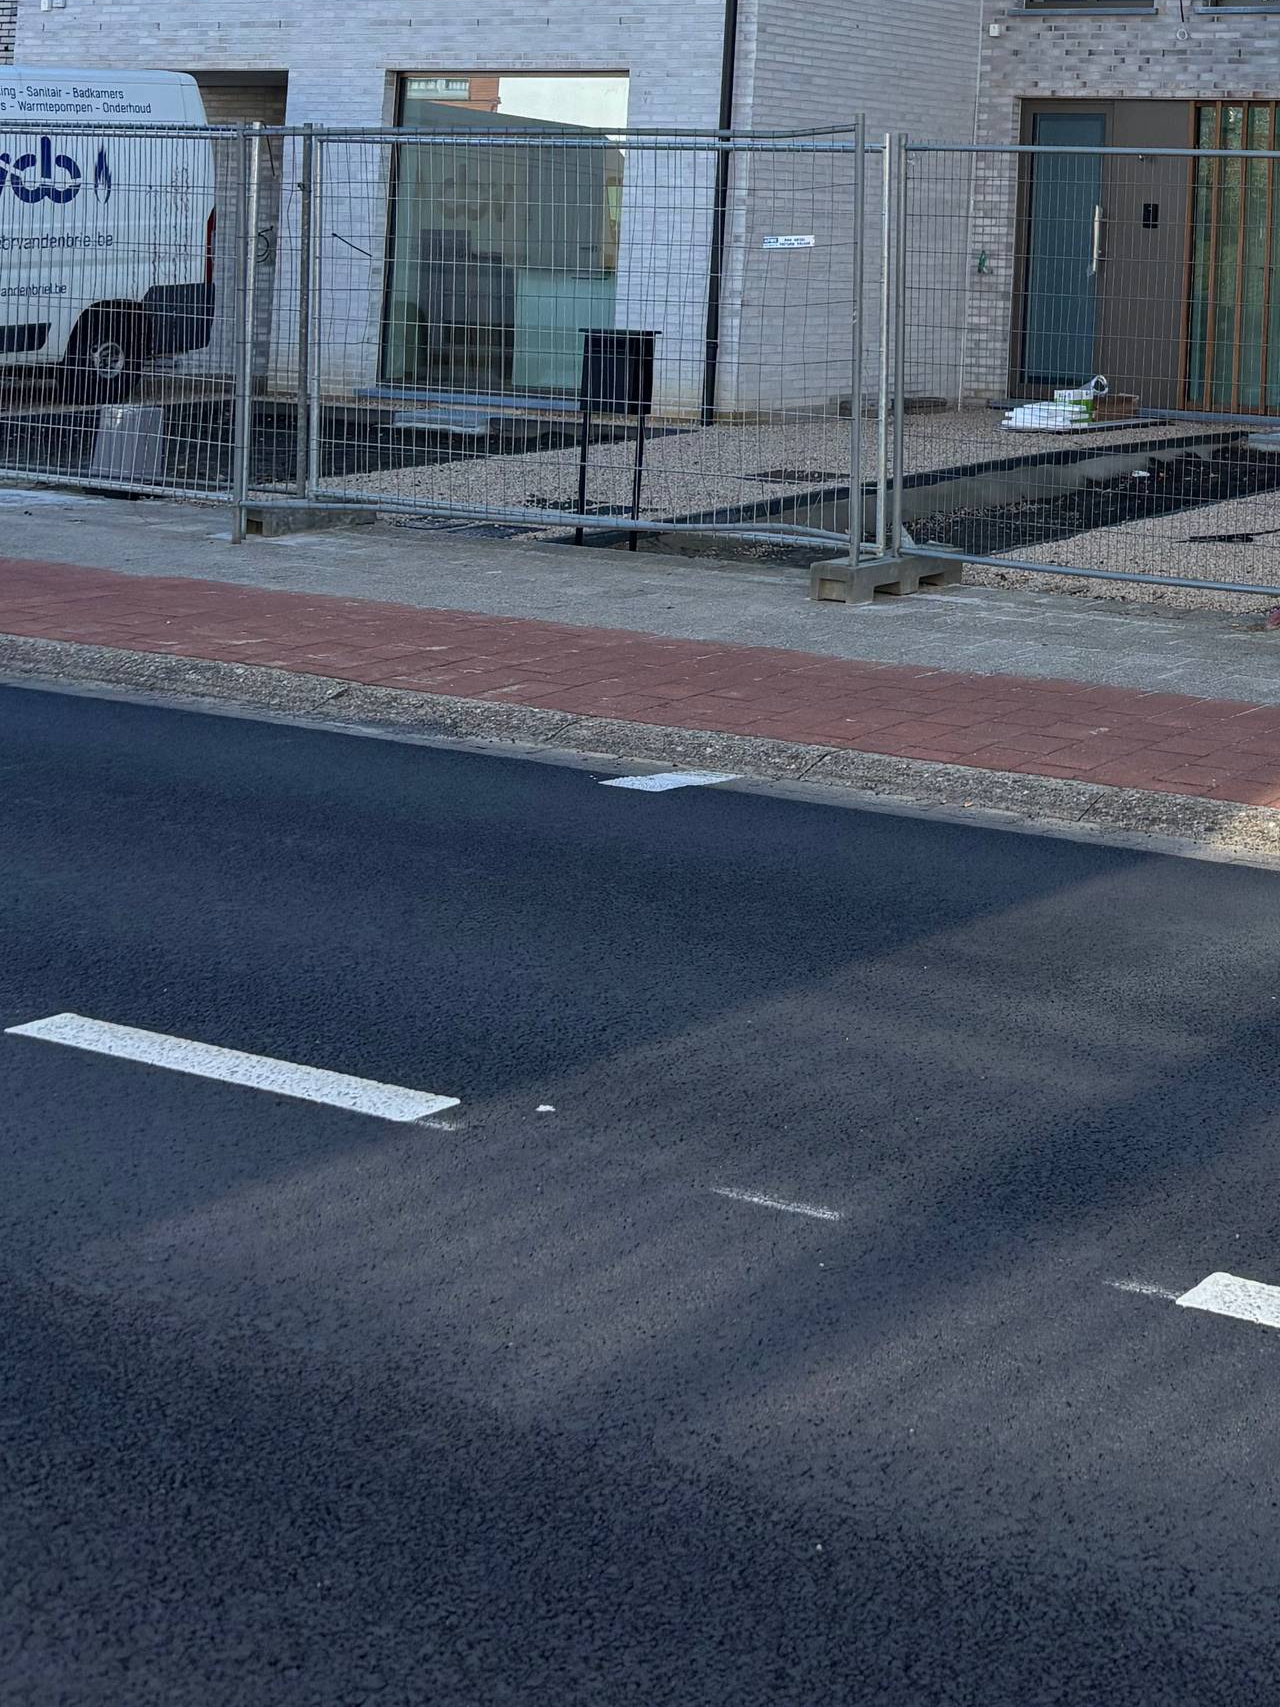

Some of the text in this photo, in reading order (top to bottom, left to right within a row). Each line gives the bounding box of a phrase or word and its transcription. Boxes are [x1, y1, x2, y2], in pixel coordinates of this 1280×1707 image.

[26, 85, 62, 97] Sanitair
[73, 87, 124, 99] Badkamers
[18, 100, 93, 114] Warmtepompen
[103, 102, 152, 113] Onderhoud
